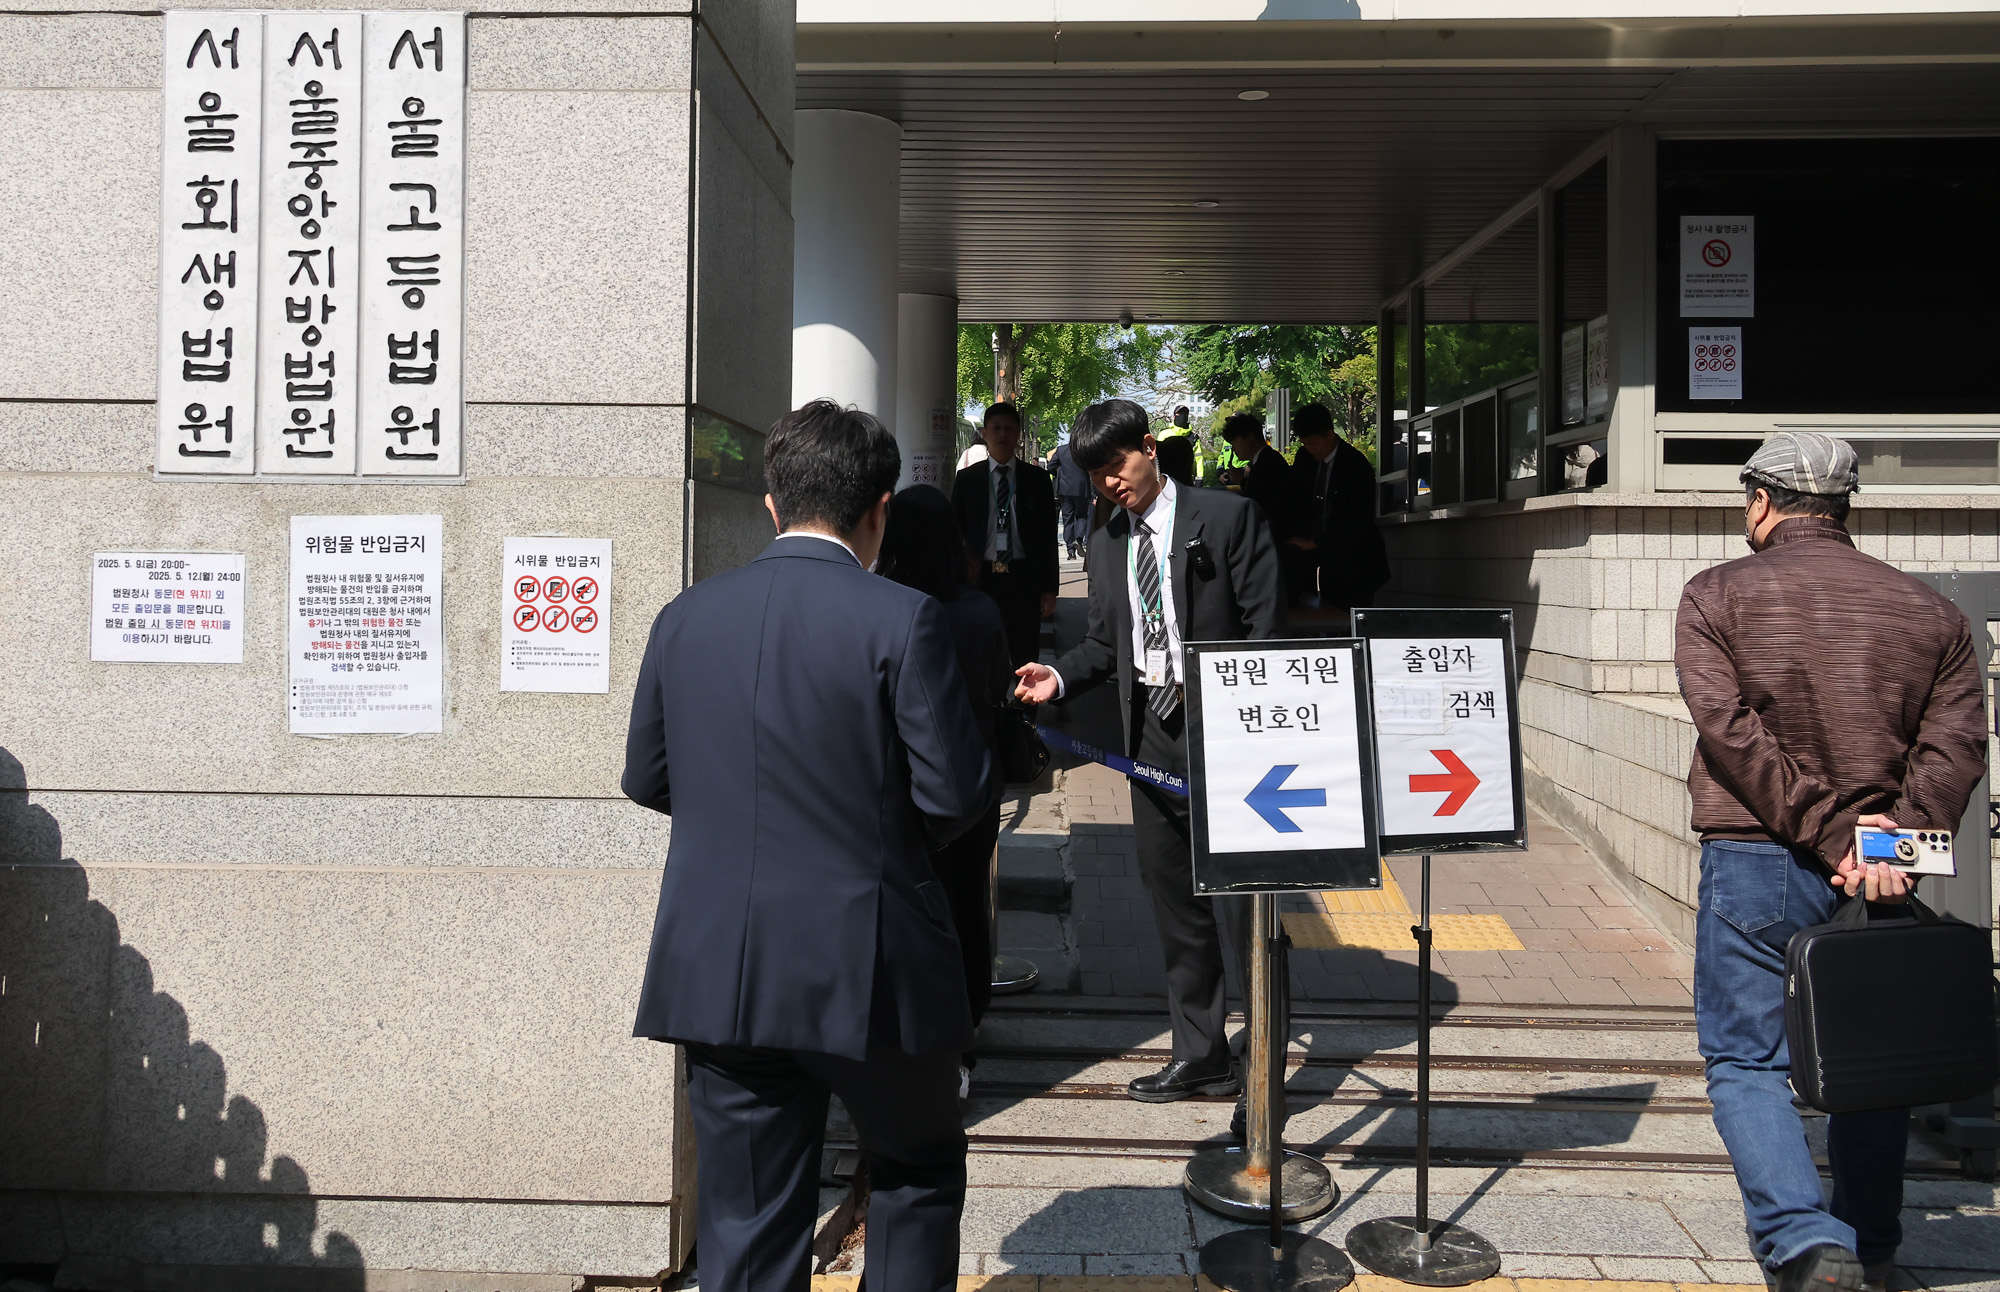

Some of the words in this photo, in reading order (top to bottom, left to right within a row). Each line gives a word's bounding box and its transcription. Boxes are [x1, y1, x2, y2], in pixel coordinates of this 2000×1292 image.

[178, 27, 239, 458] 서울회생법원
[283, 28, 342, 458] 서울중앙지방법원
[385, 27, 443, 461] 서울고등법원
[306, 536, 354, 553] 위험물
[361, 536, 424, 553] 반입금지
[98, 559, 120, 568] 2025.
[125, 560, 131, 568] 5.
[515, 555, 548, 567] 시위물
[556, 556, 599, 568] 반입금지
[149, 572, 171, 580] 2025.
[176, 572, 183, 580] 5.
[218, 573, 240, 581] 24:00
[306, 574, 336, 583] 법원청사
[339, 574, 346, 583] 내
[349, 574, 372, 583] 위험물
[375, 574, 382, 582] 및
[385, 574, 424, 582] 질서유지에
[113, 589, 149, 598] 법원청사
[216, 590, 224, 599] 외
[307, 586, 337, 594] 방해되는
[340, 585, 363, 594] 물건의
[366, 583, 389, 594] 반입을
[391, 585, 422, 593] 금지하며
[299, 597, 336, 605] 법원조직법
[340, 596, 364, 605] 55조의
[367, 597, 374, 605] 2,
[377, 596, 397, 605] 3항에
[400, 596, 431, 604] 근거하여
[112, 604, 129, 613] 모든
[135, 604, 171, 614] 출입문을
[177, 605, 225, 614] 폐문합니다.
[299, 608, 360, 616] 법원보안관리대의
[363, 607, 387, 616] 대원은
[390, 607, 404, 616] 청사
[407, 607, 430, 615] 내에서
[106, 618, 122, 628] 법원
[128, 619, 145, 629] 출입
[151, 619, 160, 629] 시
[308, 619, 332, 628] 흉기나
[344, 619, 359, 627] 밖의
[362, 618, 386, 629] 위험한
[388, 618, 403, 629] 물건
[406, 619, 421, 628] 또는
[123, 634, 168, 643] 이용하시기
[174, 635, 212, 644] 바랍니다.
[320, 630, 351, 638] 법원청사
[354, 630, 368, 638] 내의
[372, 629, 410, 638] 질서유지에
[312, 641, 342, 650] 방해되는
[345, 641, 368, 649] 물건을
[371, 641, 394, 649] 지니고
[397, 640, 419, 650] 있는지
[304, 652, 334, 661] 확인하기
[337, 652, 360, 660] 위하여
[363, 652, 394, 660] 법원청사
[397, 651, 427, 660] 출입자를
[1403, 645, 1475, 672] 출입자
[331, 663, 354, 672] 검색할
[356, 663, 364, 671] 수
[367, 663, 400, 671] 있습니다.
[1214, 658, 1267, 686] 법원
[1286, 656, 1338, 685] 직원
[1450, 691, 1495, 718] 검색
[1238, 704, 1320, 733] 변호인
[1071, 739, 1103, 762] 서울고등법원
[1133, 762, 1149, 777] Seoul
[1150, 766, 1164, 784] High
[1165, 772, 1183, 788] Court
